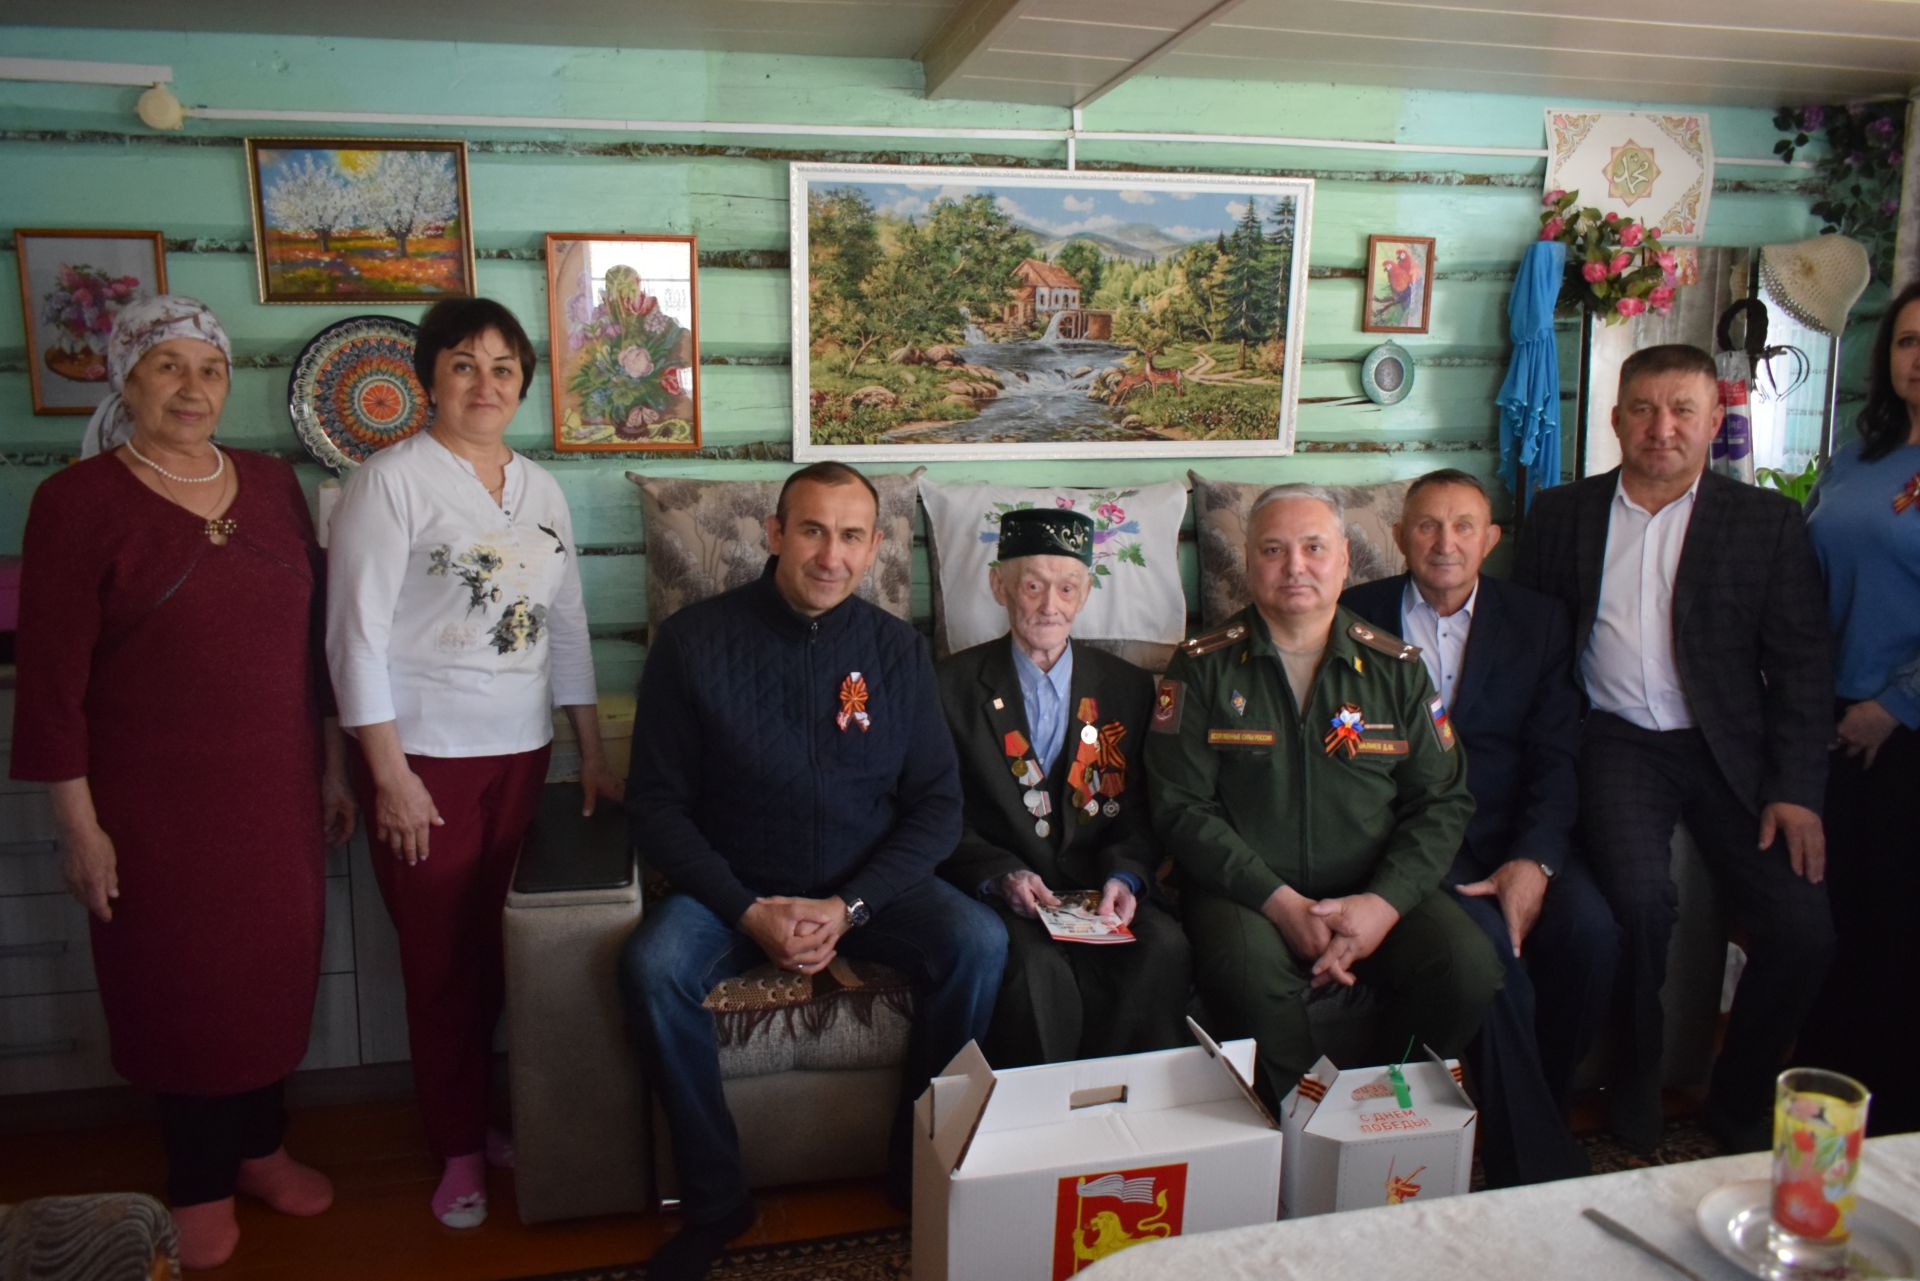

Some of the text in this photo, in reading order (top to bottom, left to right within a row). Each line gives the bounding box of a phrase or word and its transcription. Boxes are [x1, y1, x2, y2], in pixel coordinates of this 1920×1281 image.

[1360, 1110, 1415, 1122] С ДНЕМ
[1360, 1118, 1430, 1132] ПОБЕДЫ!
